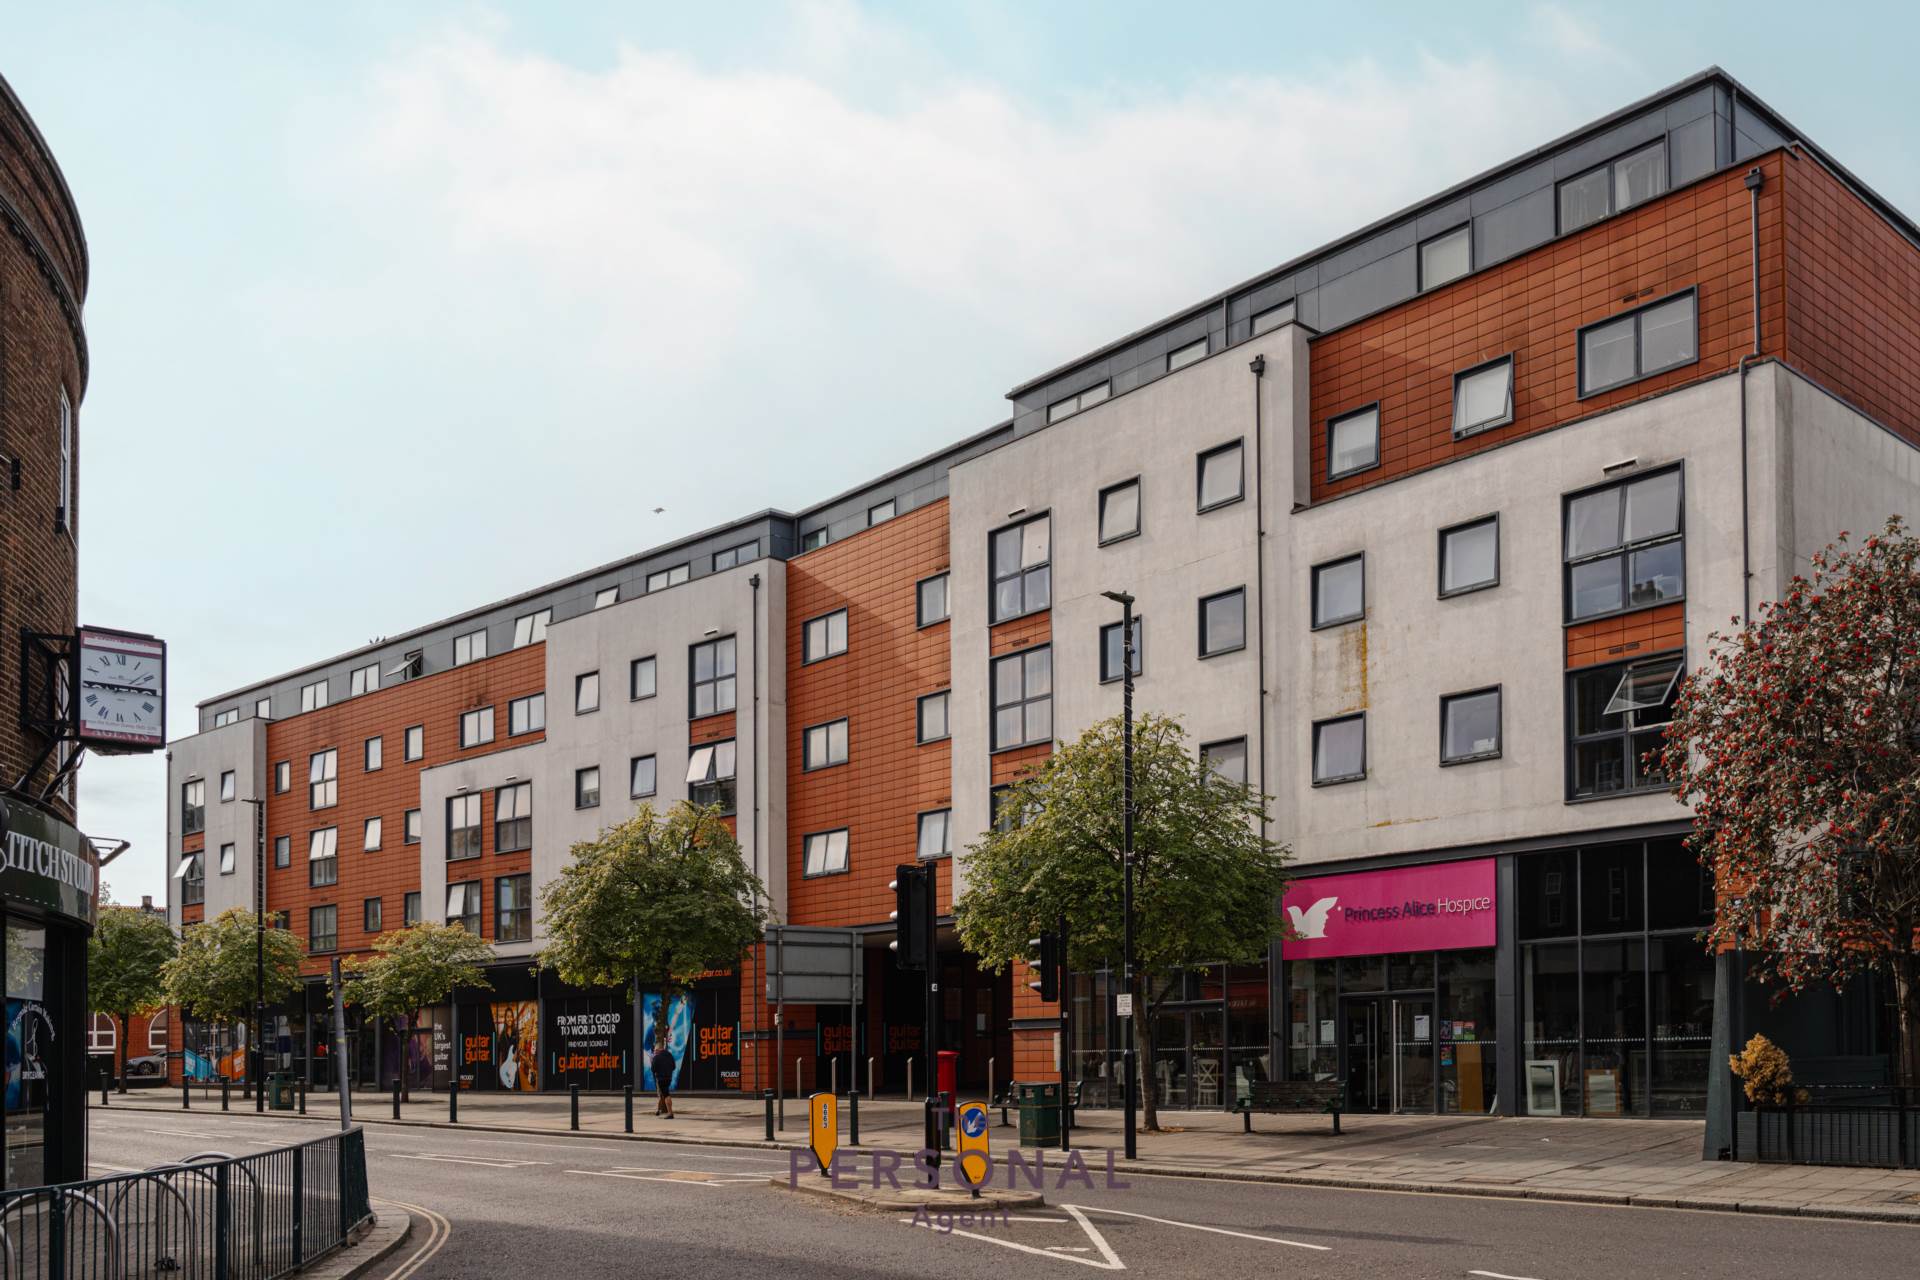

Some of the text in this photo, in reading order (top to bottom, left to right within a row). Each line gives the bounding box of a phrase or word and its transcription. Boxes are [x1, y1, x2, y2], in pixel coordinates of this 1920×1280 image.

[1344, 897, 1490, 921] Princess Alice Hospice
[557, 1015, 577, 1027] FROM
[595, 1013, 621, 1024] CHORD
[560, 1026, 570, 1036] TO
[597, 1024, 616, 1035] TOUR
[700, 1024, 734, 1043] guitar
[824, 1024, 856, 1041] guita
[824, 1038, 856, 1055] guita
